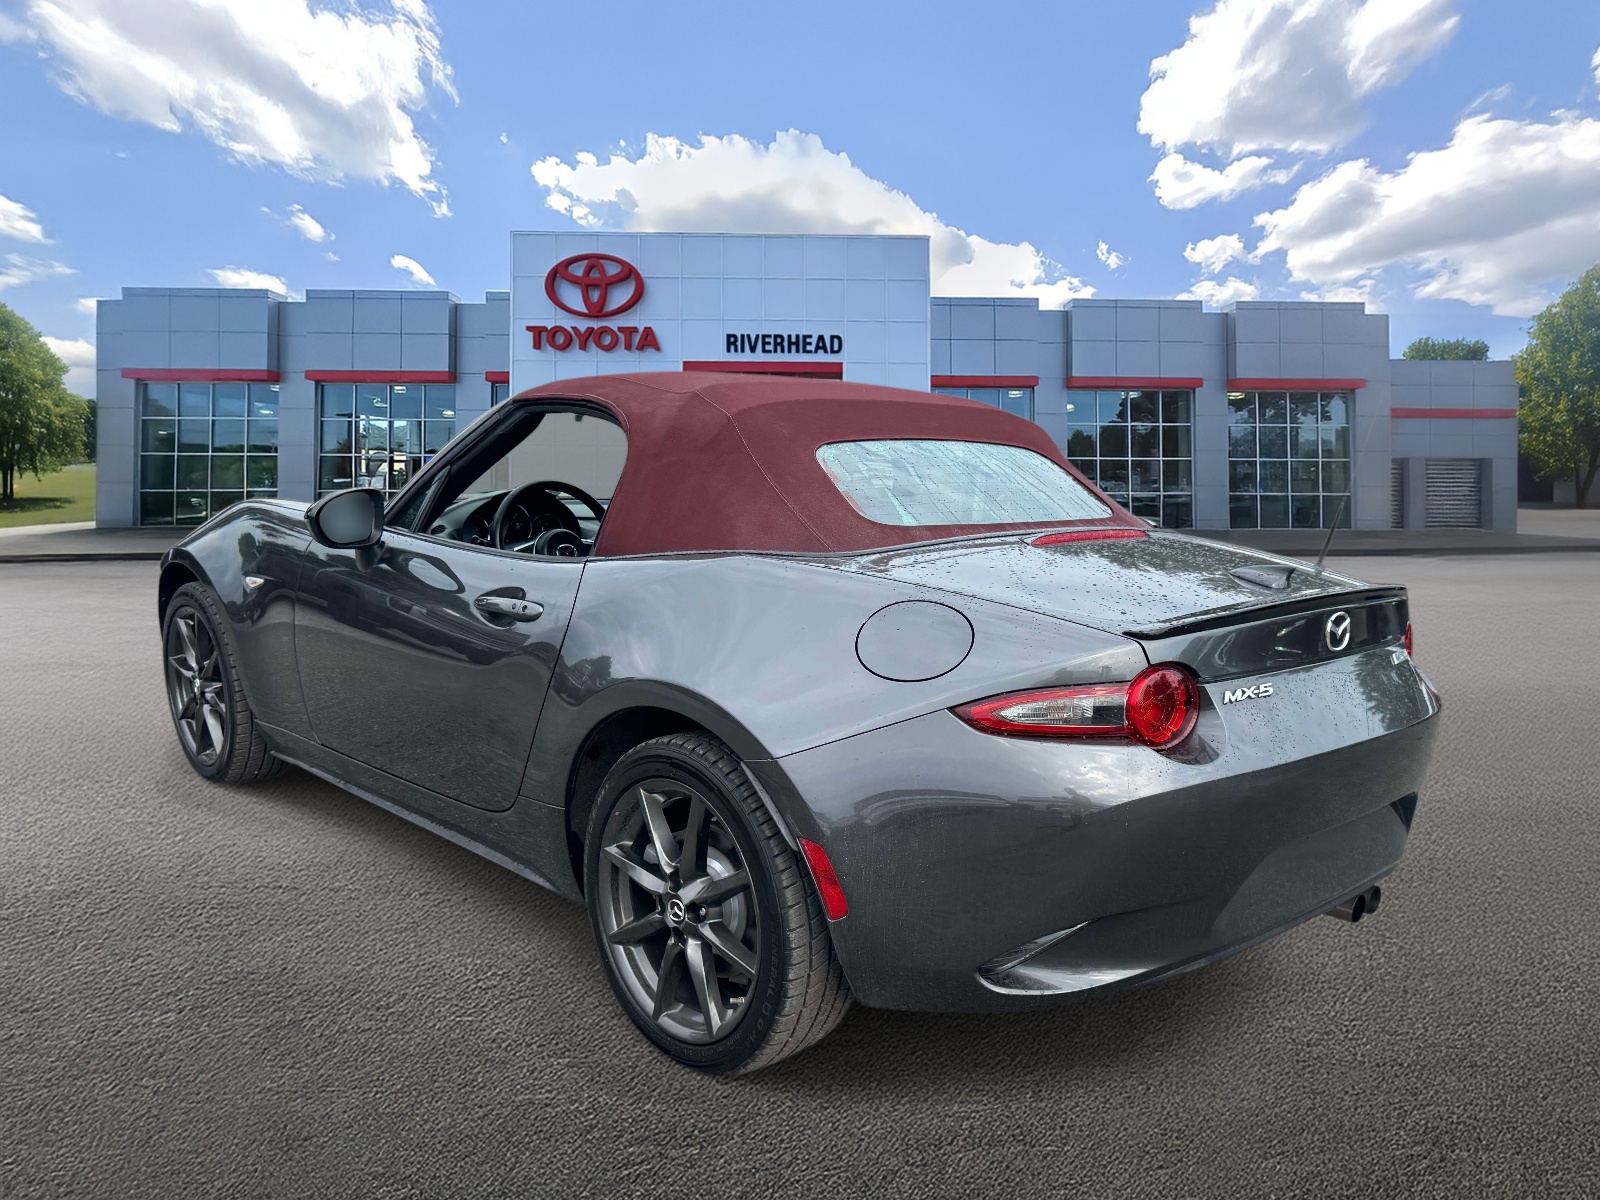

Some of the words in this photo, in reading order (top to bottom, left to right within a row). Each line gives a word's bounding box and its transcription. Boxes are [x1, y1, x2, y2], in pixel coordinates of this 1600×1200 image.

[526, 325, 661, 352] TOYOTA
[725, 333, 844, 355] RIVERHEAD
[1222, 682, 1274, 705] MX-5
